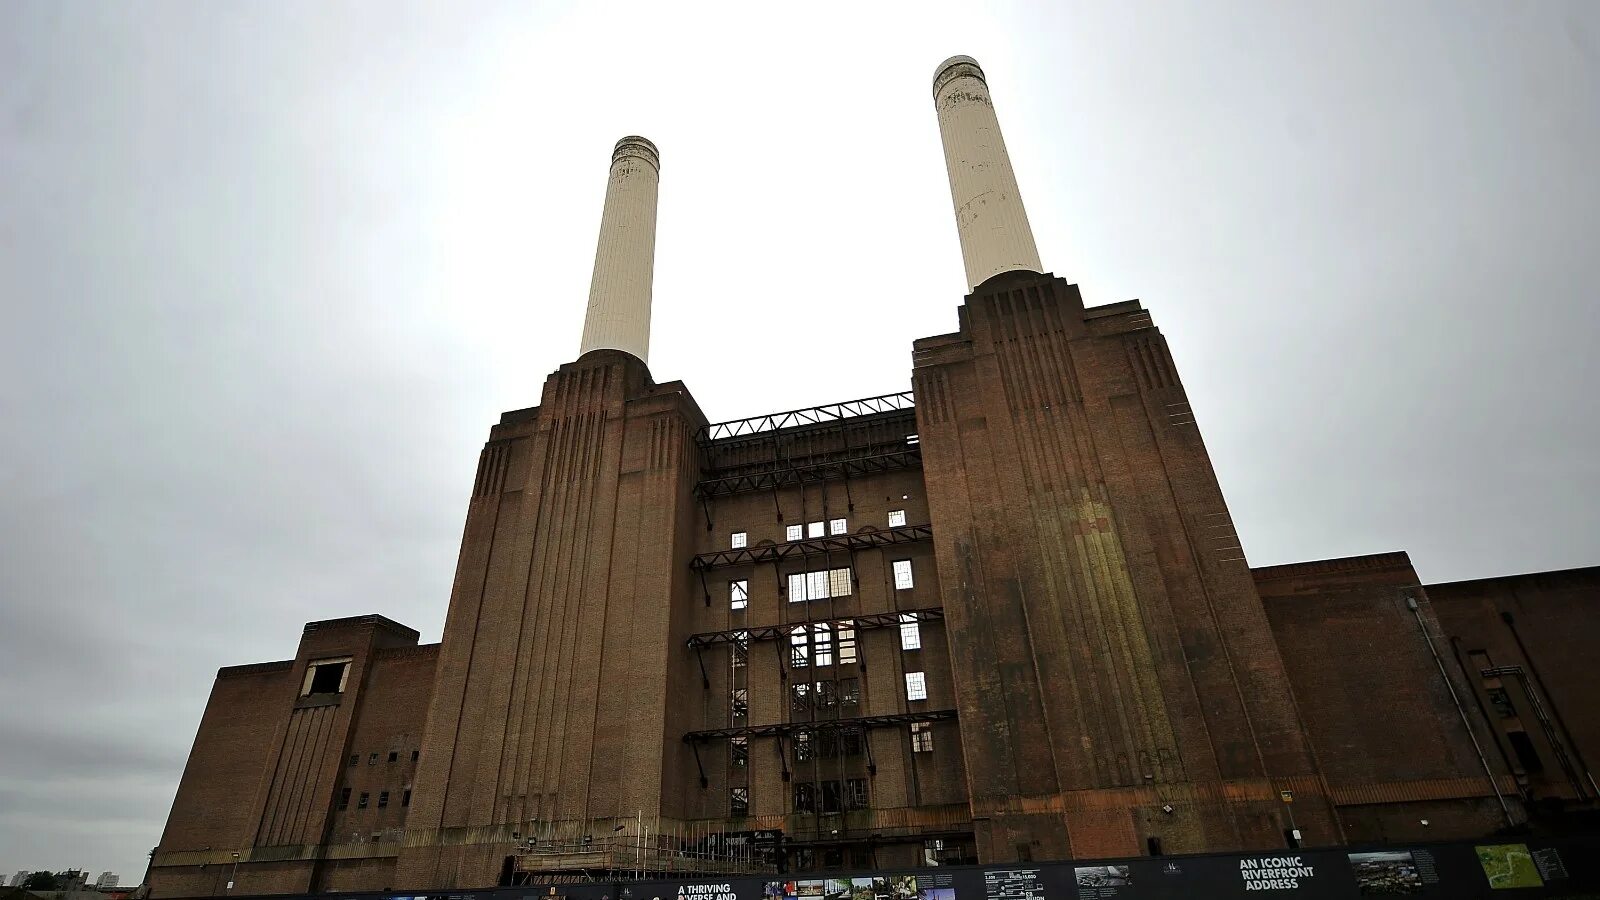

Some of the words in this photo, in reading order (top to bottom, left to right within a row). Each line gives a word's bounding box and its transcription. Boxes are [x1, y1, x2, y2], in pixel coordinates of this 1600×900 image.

[1240, 859, 1258, 869] AN
[1260, 857, 1302, 868] ICONIC
[1242, 867, 1314, 880] RIVERFRONT
[678, 885, 685, 894] A
[687, 883, 731, 894] THRIVING
[1246, 878, 1299, 891] ADDRESS
